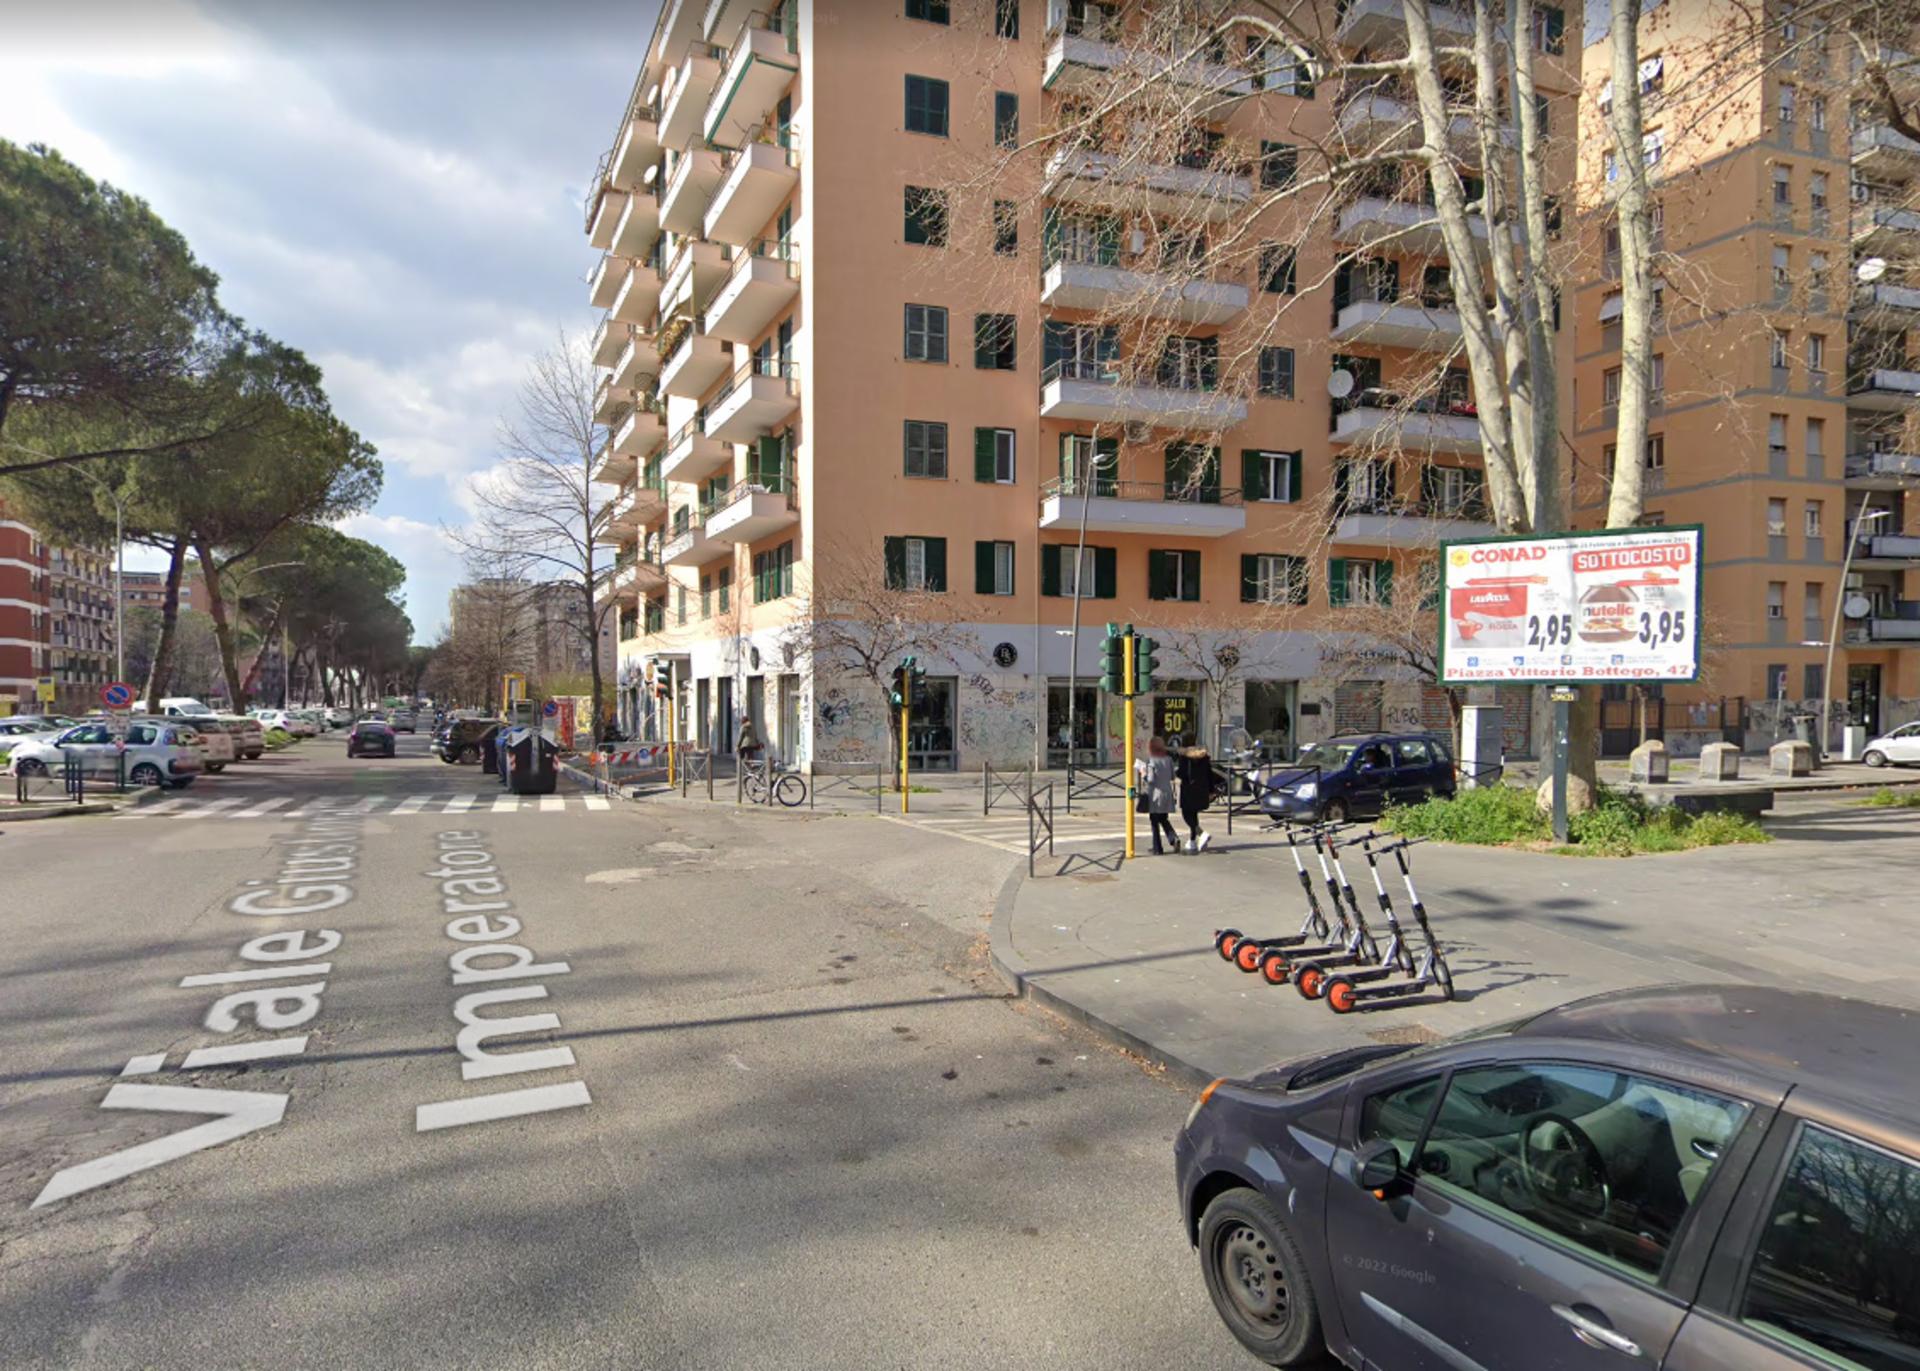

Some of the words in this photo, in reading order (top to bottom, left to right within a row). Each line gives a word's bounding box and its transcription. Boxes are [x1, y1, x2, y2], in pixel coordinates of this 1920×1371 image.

[1471, 546, 1547, 564] CONAD
[1577, 546, 1686, 569] SOTTOCOSTO
[1528, 613, 1572, 651] 2,95
[1639, 610, 1685, 650] 3,95
[1446, 668, 1504, 677] Piazza
[1508, 666, 1577, 676] Vittorio
